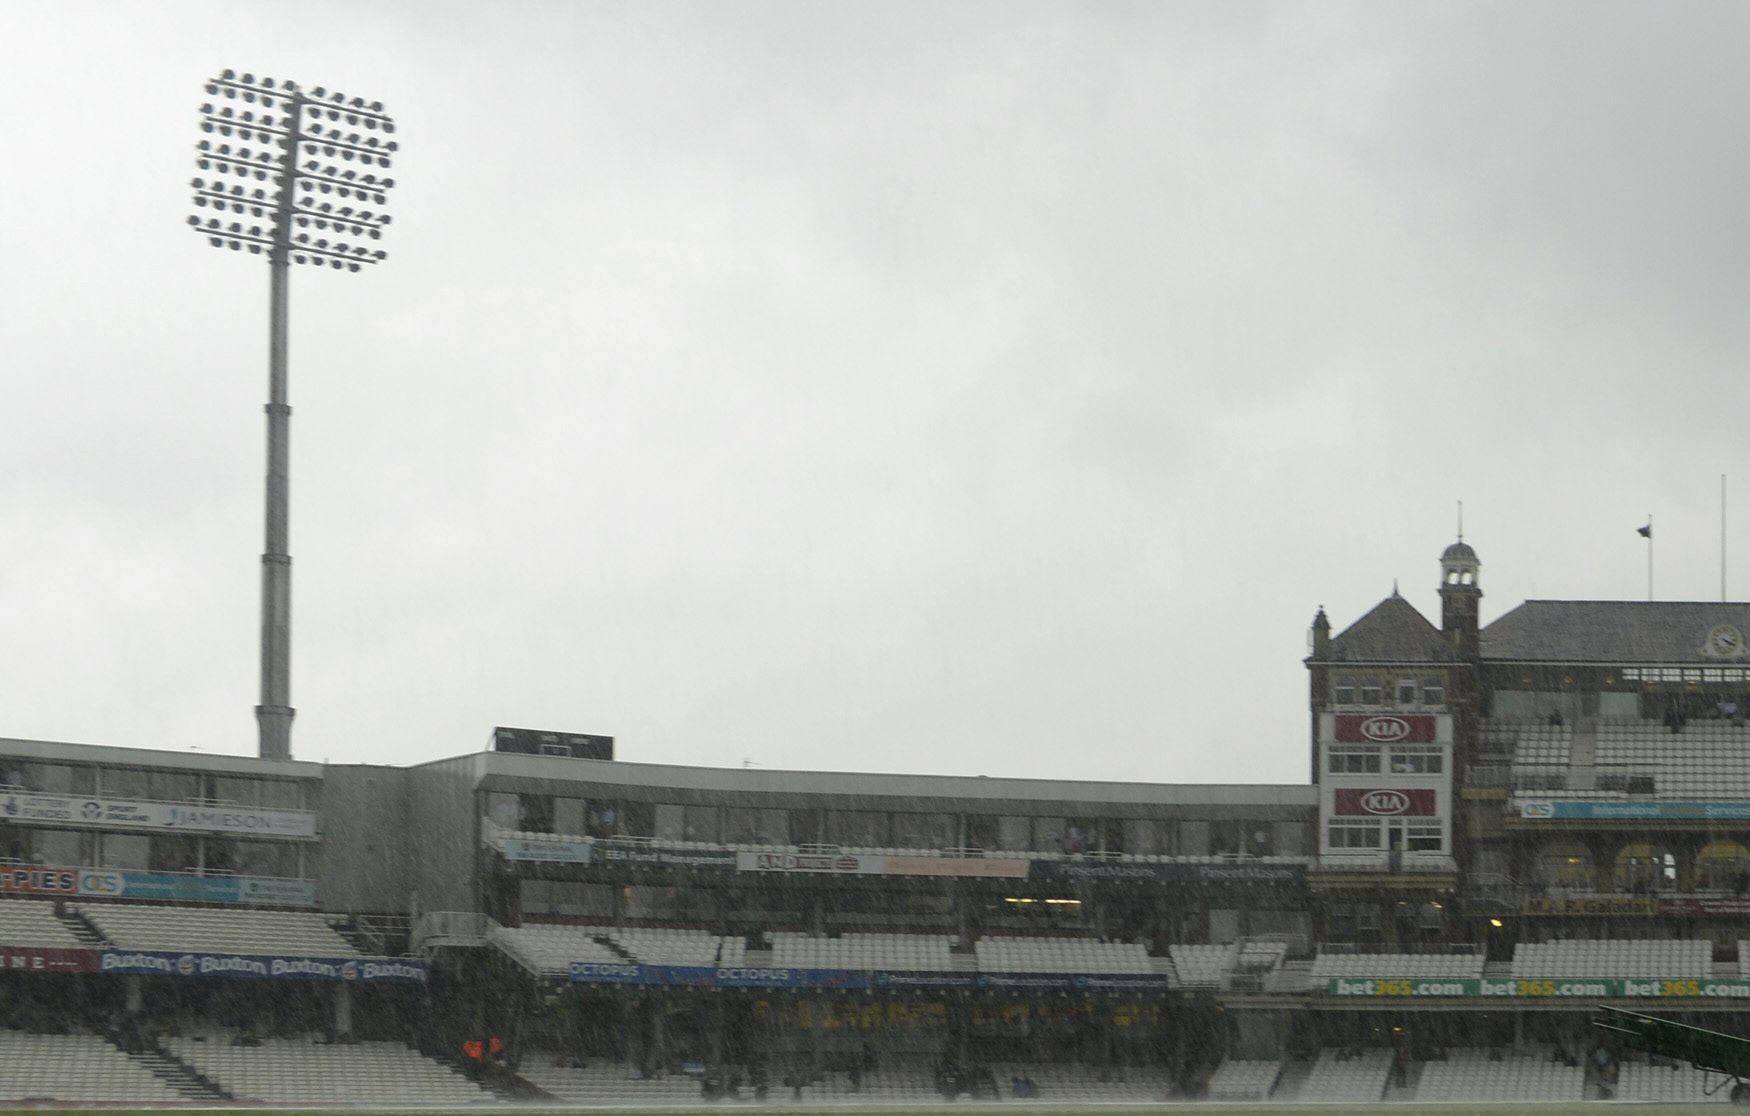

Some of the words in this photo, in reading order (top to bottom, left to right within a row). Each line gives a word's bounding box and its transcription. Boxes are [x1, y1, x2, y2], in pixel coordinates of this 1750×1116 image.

[23, 808, 71, 819] FUNDED
[1704, 805, 1750, 816] Services
[179, 811, 271, 829] JAMIESON
[102, 953, 171, 971] Buxton
[201, 956, 267, 974] Buxton
[271, 959, 336, 977] Buxton
[571, 963, 639, 977] OCTOPUS
[362, 962, 428, 981] Buxton
[716, 968, 789, 981] OCTOPUS
[1337, 979, 1464, 996] bet365.com
[1480, 979, 1606, 996] bet365.com
[1624, 980, 1750, 997] bet365.com
